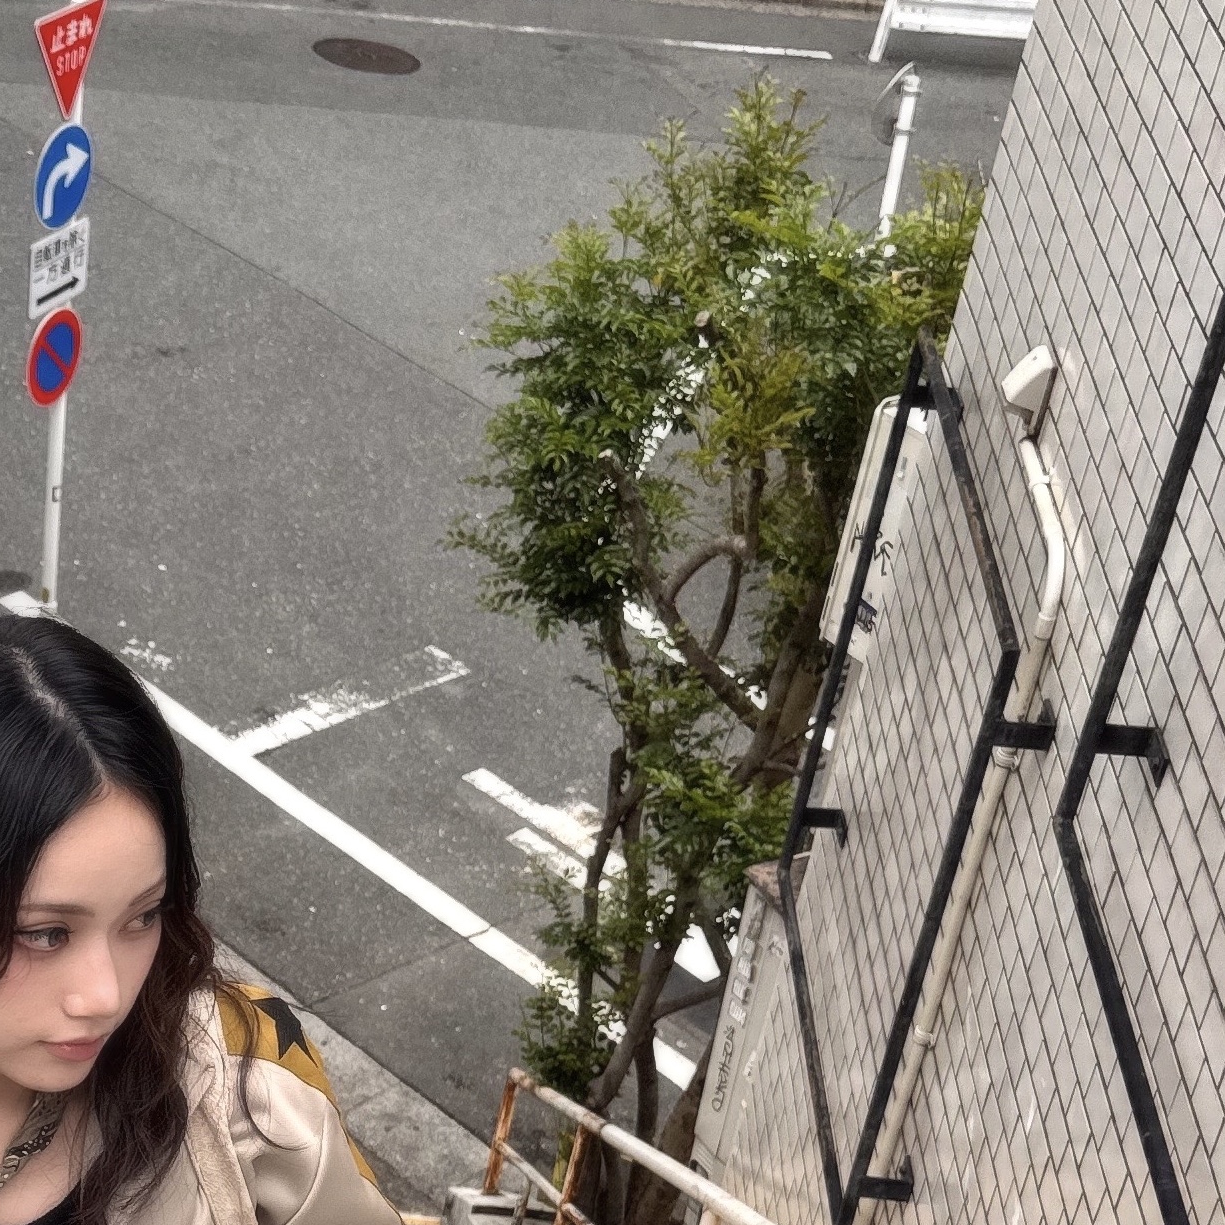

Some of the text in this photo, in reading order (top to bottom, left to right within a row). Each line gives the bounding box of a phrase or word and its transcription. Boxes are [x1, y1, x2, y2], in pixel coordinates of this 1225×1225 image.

[50, 13, 93, 53] 止まれ
[56, 46, 87, 76] STOP
